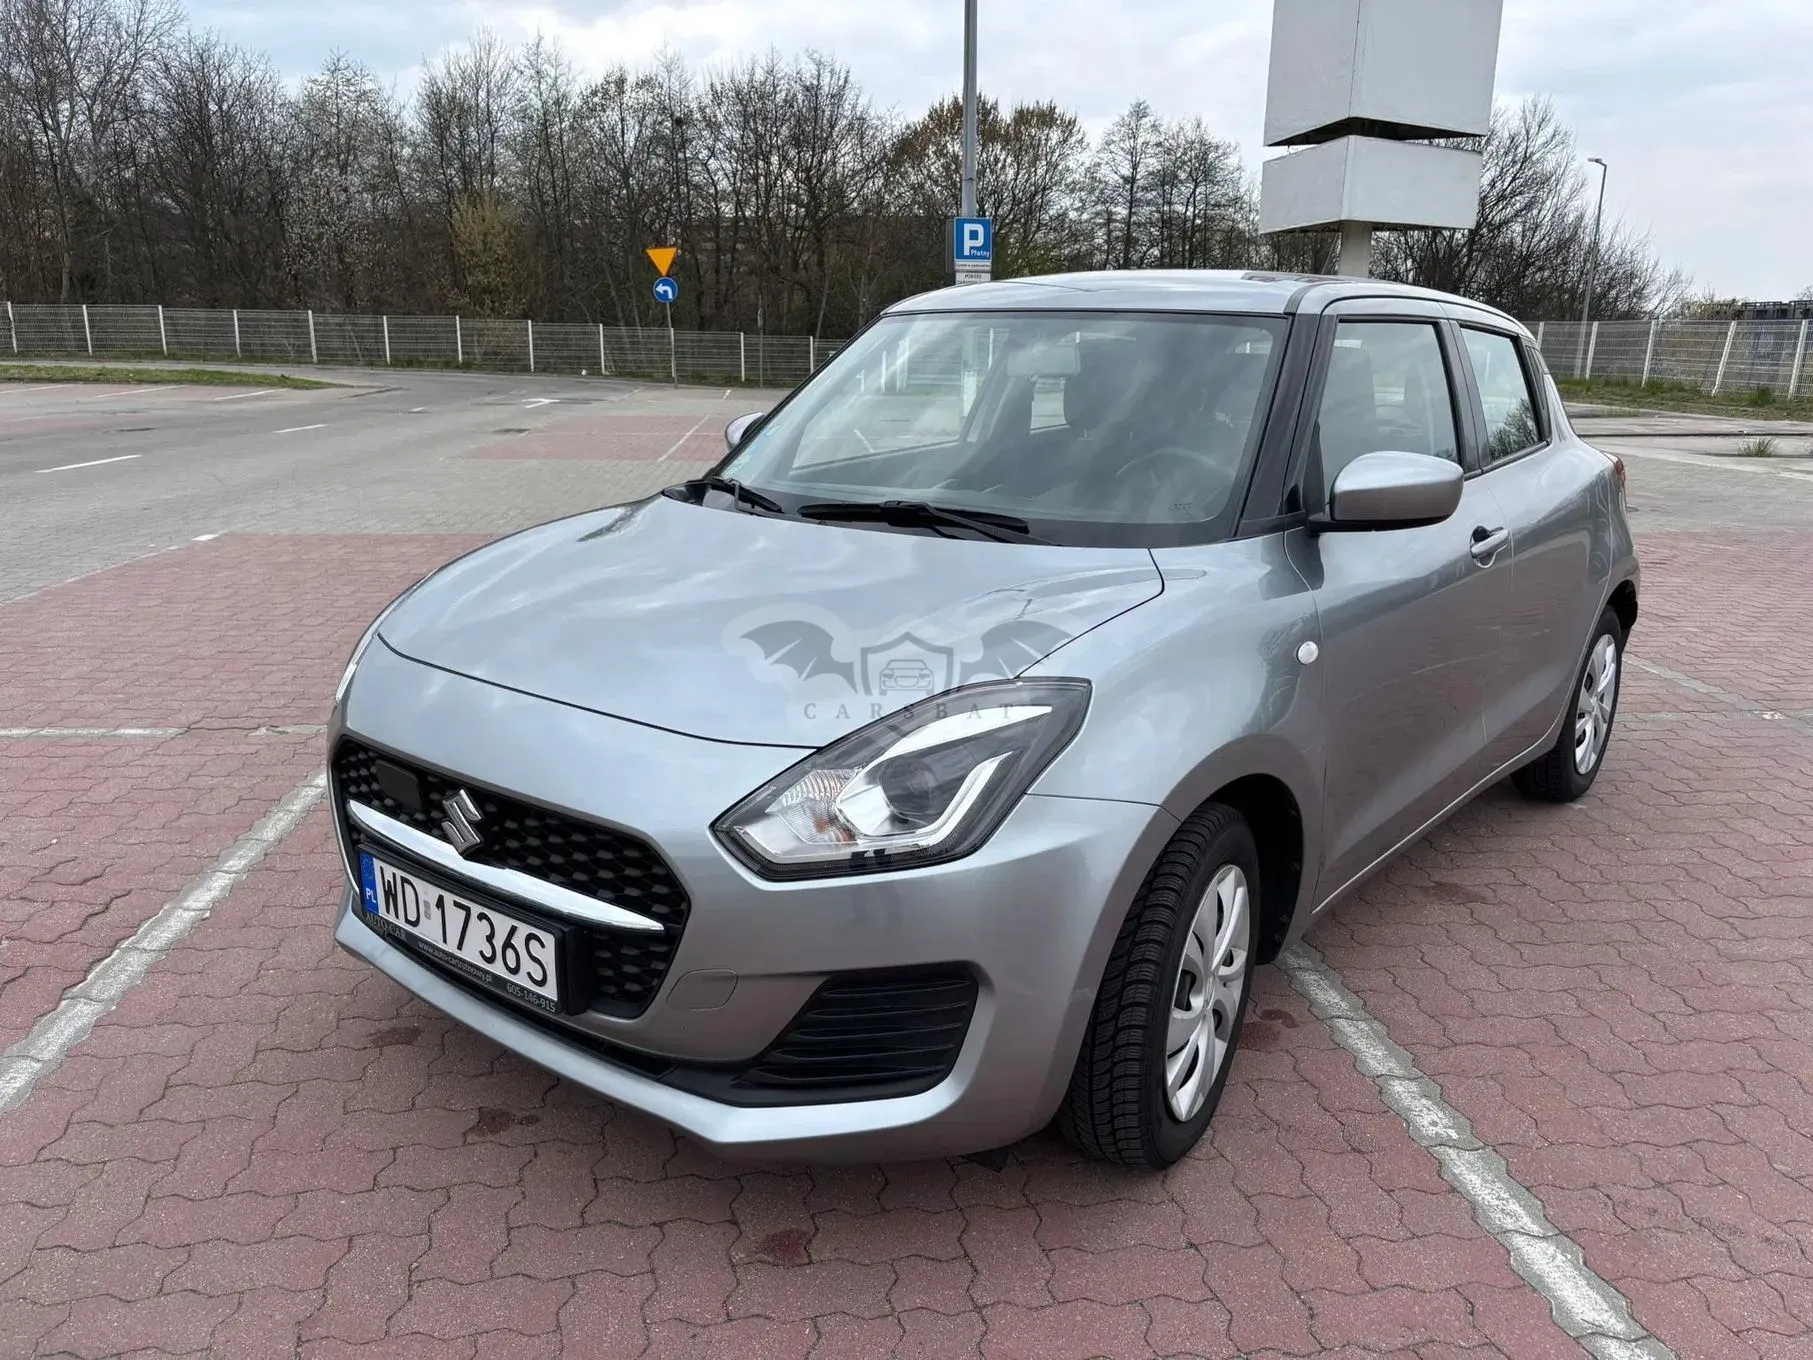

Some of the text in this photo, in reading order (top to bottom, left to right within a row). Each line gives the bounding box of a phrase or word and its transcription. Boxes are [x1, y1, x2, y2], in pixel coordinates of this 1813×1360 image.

[963, 223, 984, 256] P
[365, 887, 377, 904] PL
[380, 865, 548, 988] WD 1736S
[506, 983, 557, 1013] 605-146-915
